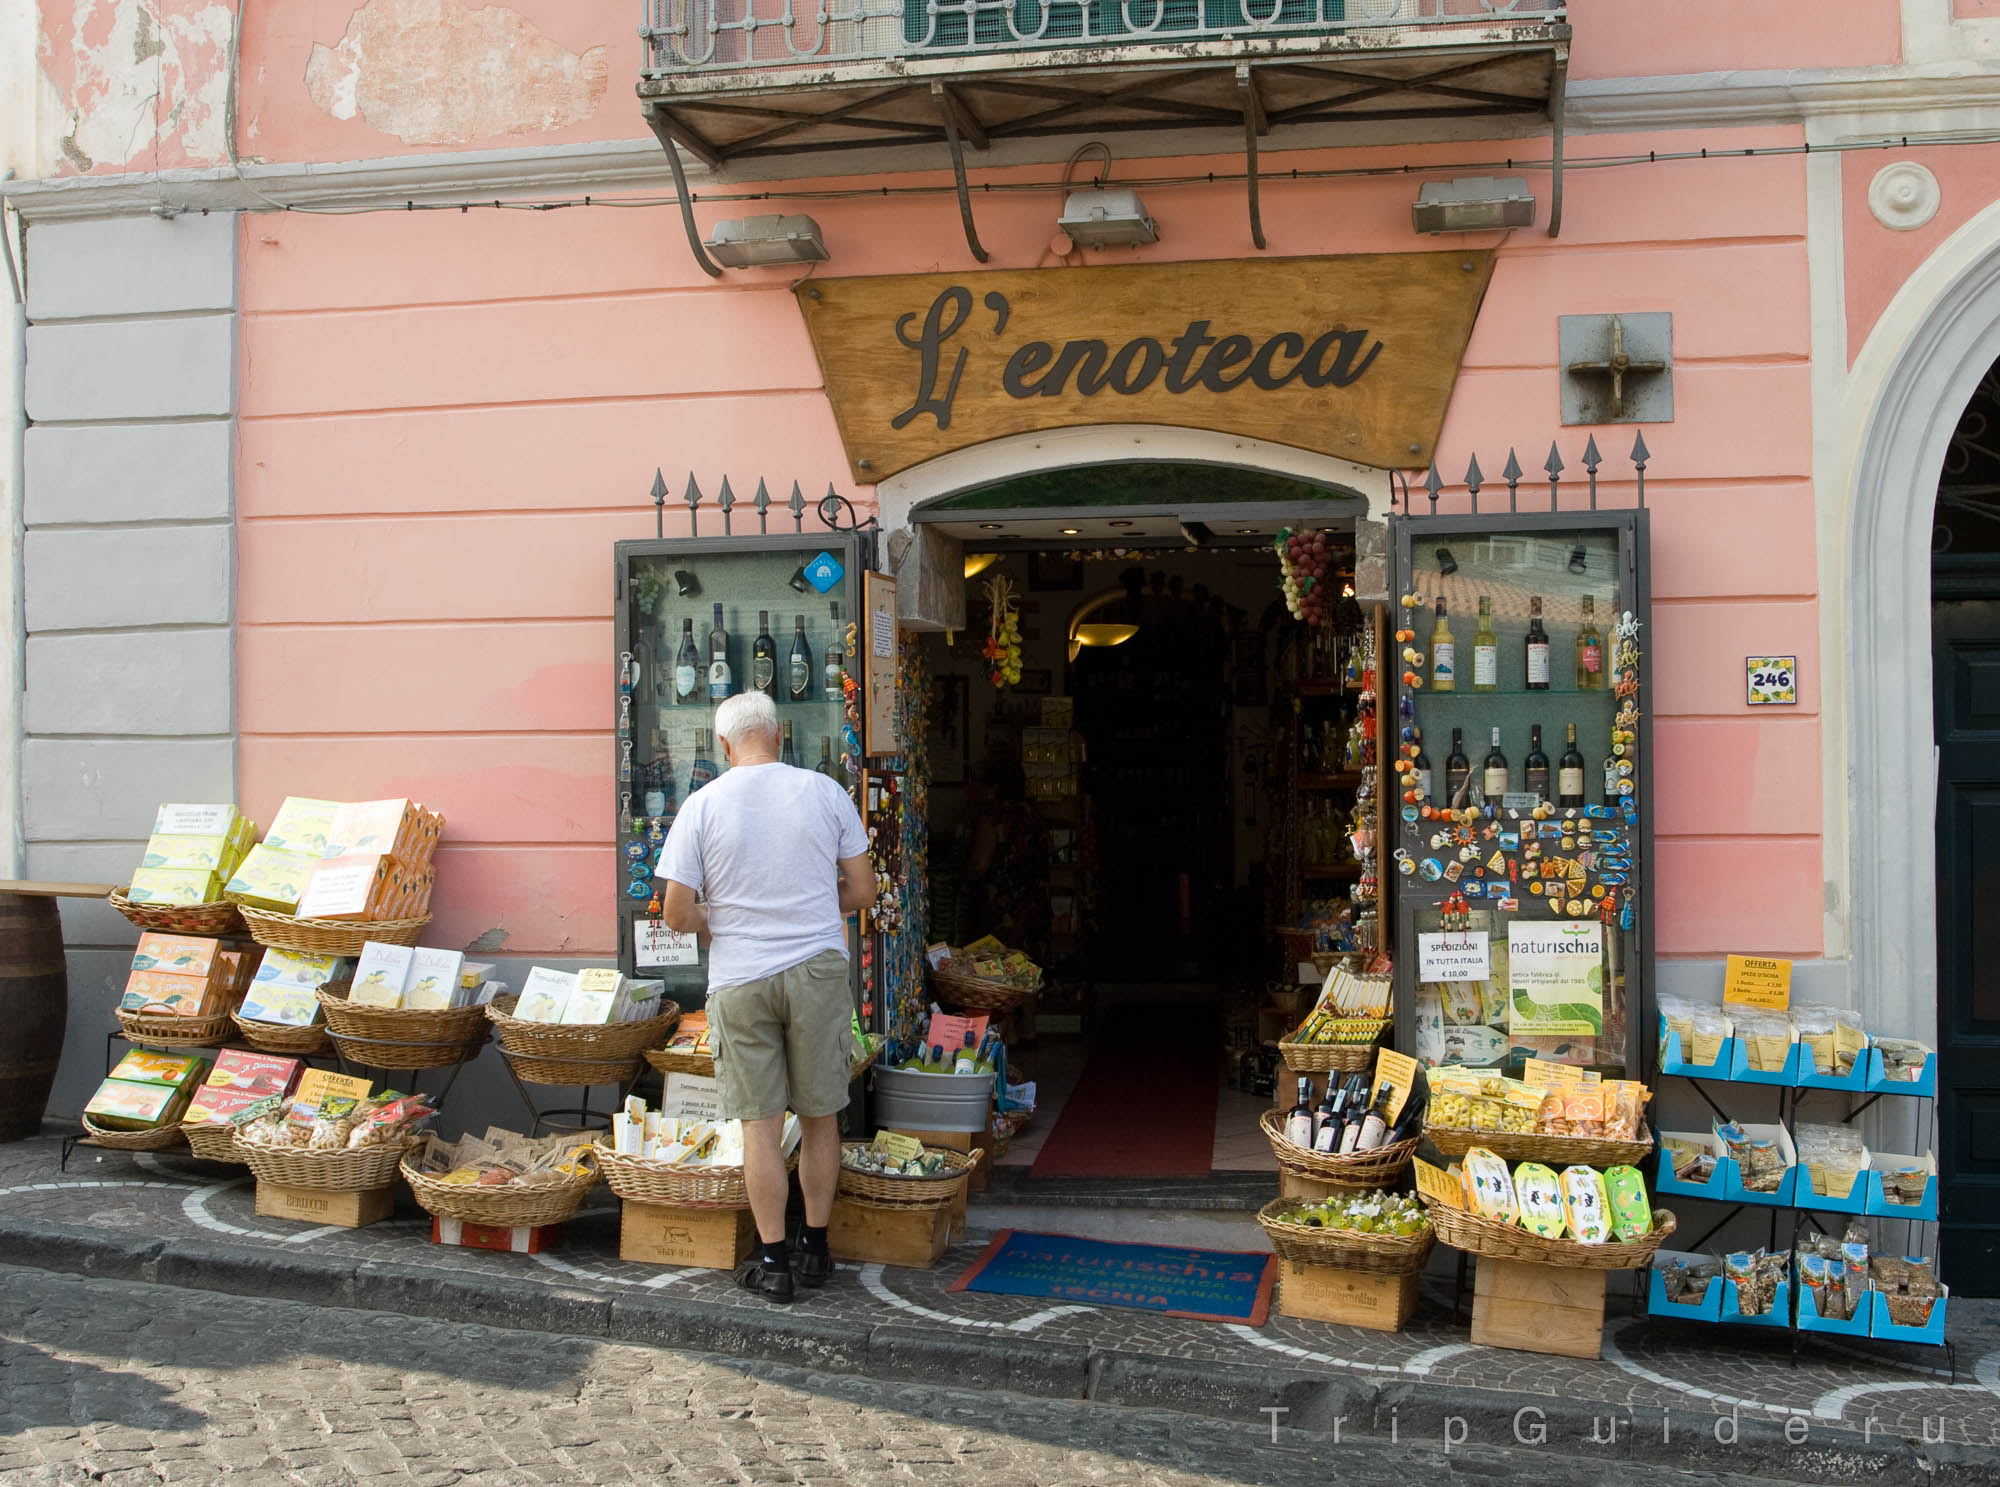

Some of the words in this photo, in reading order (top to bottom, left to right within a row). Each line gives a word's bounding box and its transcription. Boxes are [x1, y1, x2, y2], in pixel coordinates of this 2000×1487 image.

[890, 285, 1383, 431] L'enoteca
[1753, 671, 1790, 687] 246
[1431, 943, 1478, 952] SPEDIZIONI
[1511, 938, 1600, 954] naturischia
[1744, 960, 1777, 969] OFFERTA
